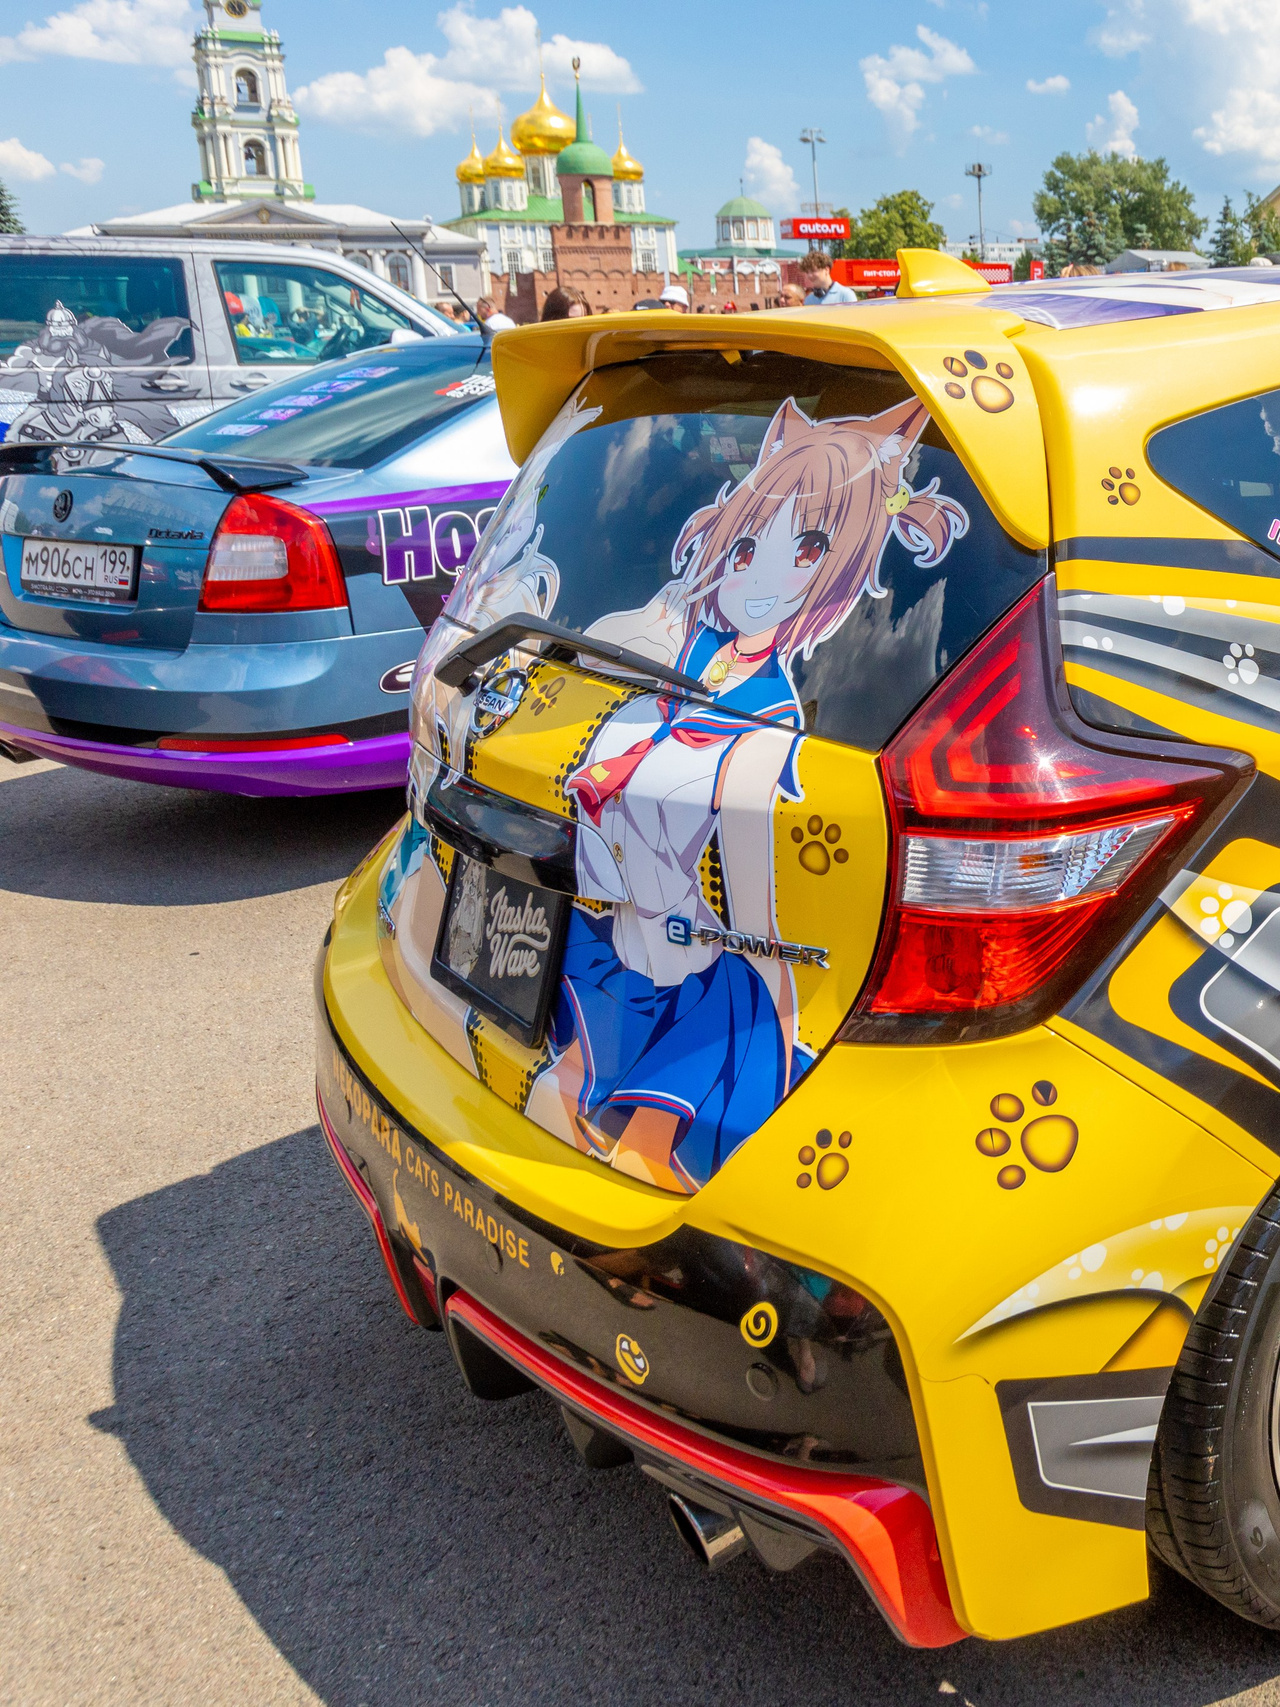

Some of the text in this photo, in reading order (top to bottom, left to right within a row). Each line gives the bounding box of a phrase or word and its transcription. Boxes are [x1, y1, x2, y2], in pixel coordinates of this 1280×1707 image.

[799, 222, 845, 235] auto.ru
[147, 528, 204, 540] Octavia
[100, 550, 127, 574] 199
[104, 575, 118, 584] RUS
[486, 886, 549, 944] Itasha
[488, 932, 541, 978] Wave
[666, 914, 831, 970] e-POWER
[333, 1049, 530, 1268] NEKOPARA CATS PARADISE
